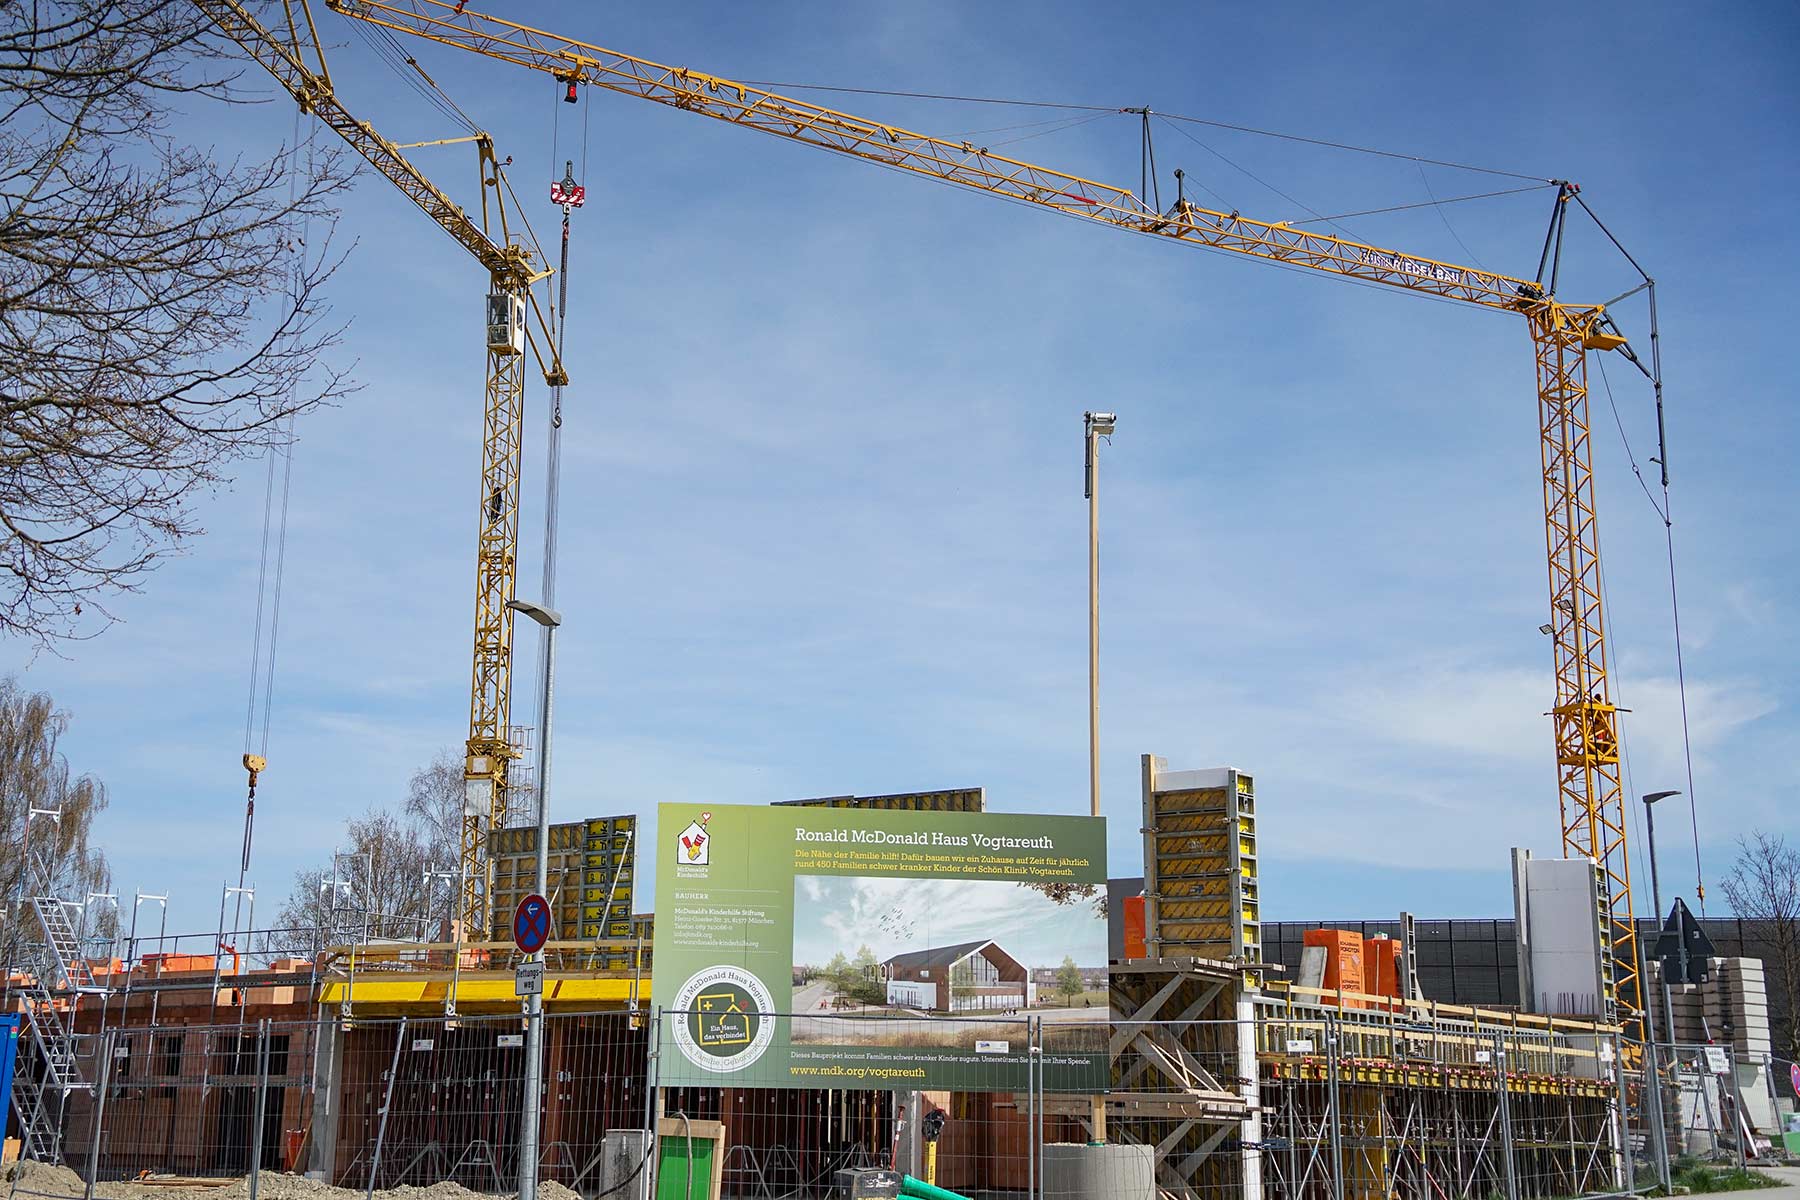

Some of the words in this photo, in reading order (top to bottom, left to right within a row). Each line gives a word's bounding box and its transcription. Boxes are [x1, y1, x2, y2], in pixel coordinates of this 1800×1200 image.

[795, 828, 848, 843] Ronald
[851, 830, 928, 845] McDonald
[931, 832, 968, 847] Haus
[971, 833, 1053, 850] Vogtareuth
[795, 850, 809, 858] Die
[811, 849, 832, 858] Nähe
[834, 850, 848, 859] der
[850, 851, 880, 860] Familie
[901, 852, 923, 861] Dafür
[926, 854, 950, 862] bauen
[967, 855, 979, 863] ein
[981, 855, 1013, 864] Zuhause
[1016, 856, 1028, 865] auf
[1029, 857, 1044, 865] Zeit
[1046, 857, 1057, 865] für
[1058, 858, 1089, 867] jährlich
[795, 860, 815, 868] rund
[832, 861, 867, 870] Familien
[869, 862, 898, 871] schwer
[900, 863, 932, 872] kranker
[933, 864, 960, 873] Kinder
[963, 864, 977, 873] der
[978, 864, 1002, 874] Schön
[1004, 866, 1028, 875] Klinik
[1029, 867, 1075, 876] Vogtareuth.
[687, 971, 726, 996] McDonald
[728, 971, 748, 985] Haus
[866, 1052, 892, 1060] Familien
[938, 1054, 958, 1062] Kinder
[790, 1064, 925, 1079] www.mdk.org/vogtareuth
